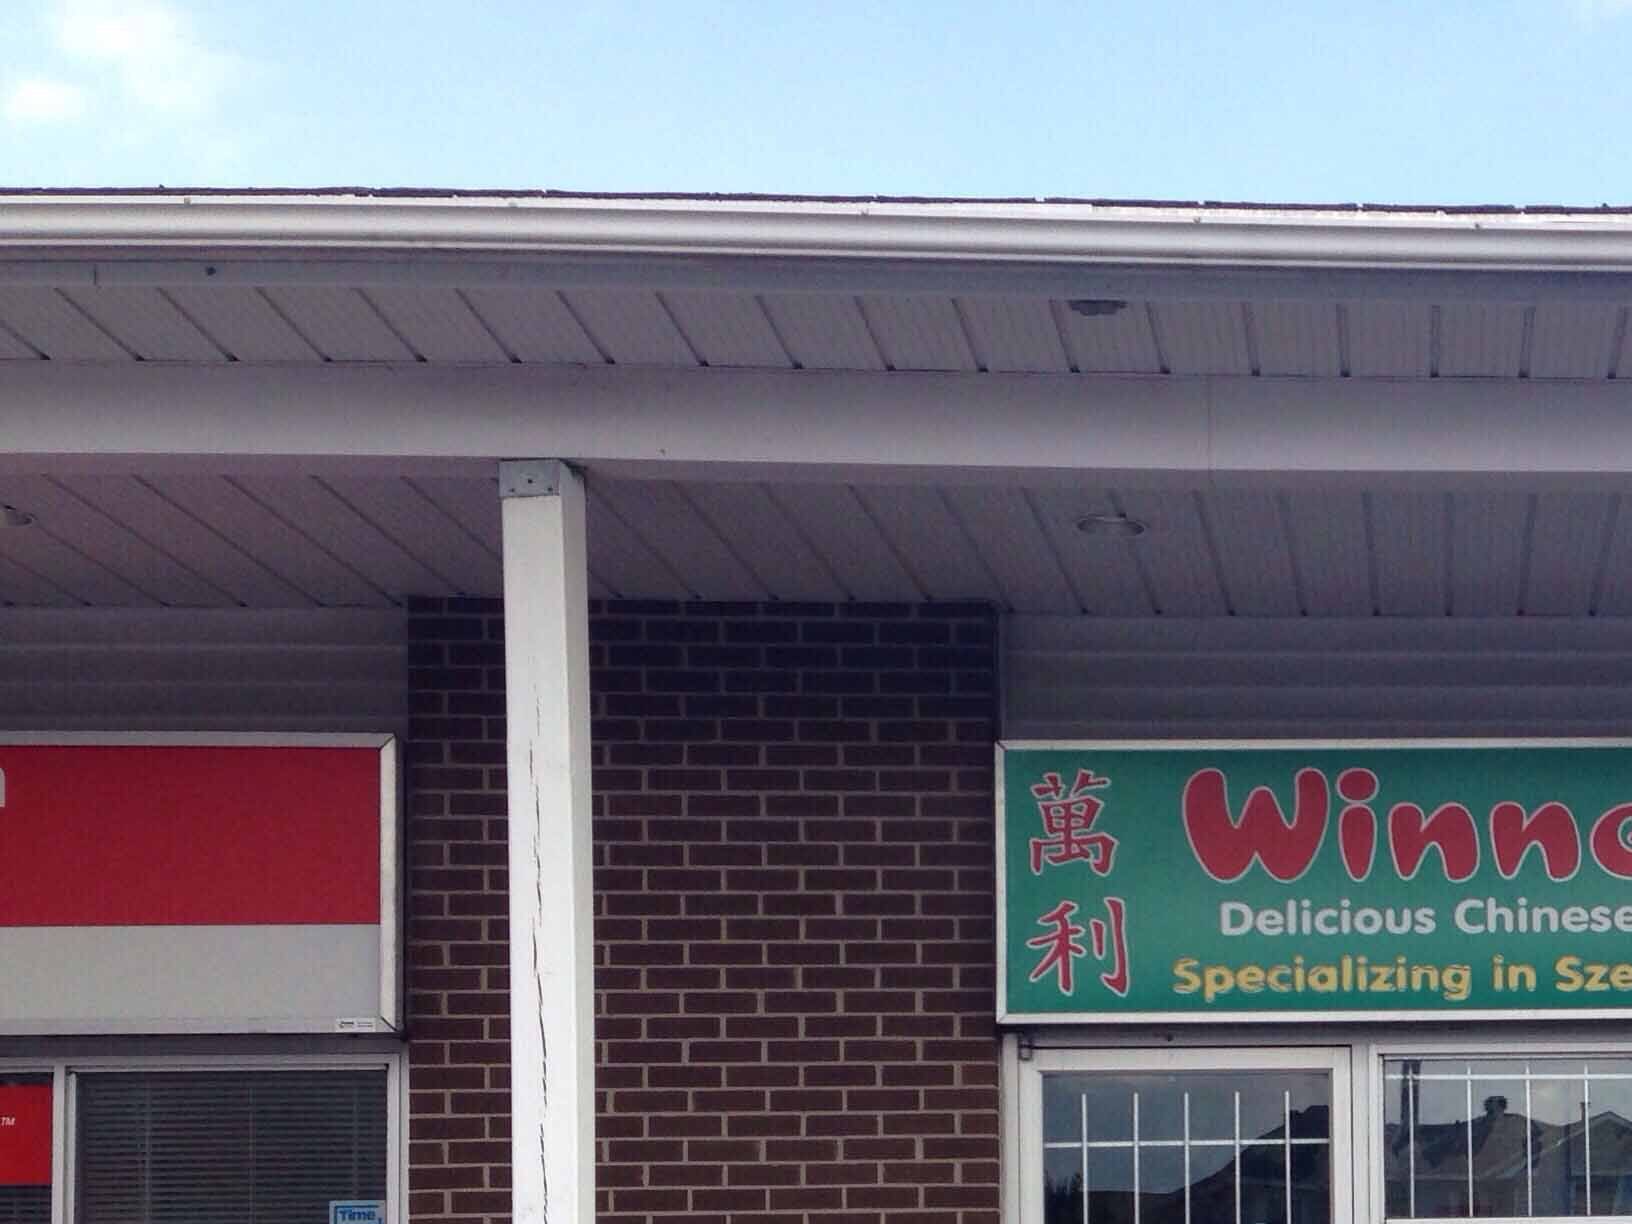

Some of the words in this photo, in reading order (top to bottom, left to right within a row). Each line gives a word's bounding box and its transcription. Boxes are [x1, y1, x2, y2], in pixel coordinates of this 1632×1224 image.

[1026, 768, 1129, 997] 萬利
[1219, 898, 1437, 937] Delicious
[1172, 954, 1472, 1003] Specializing
[1492, 954, 1537, 992] in
